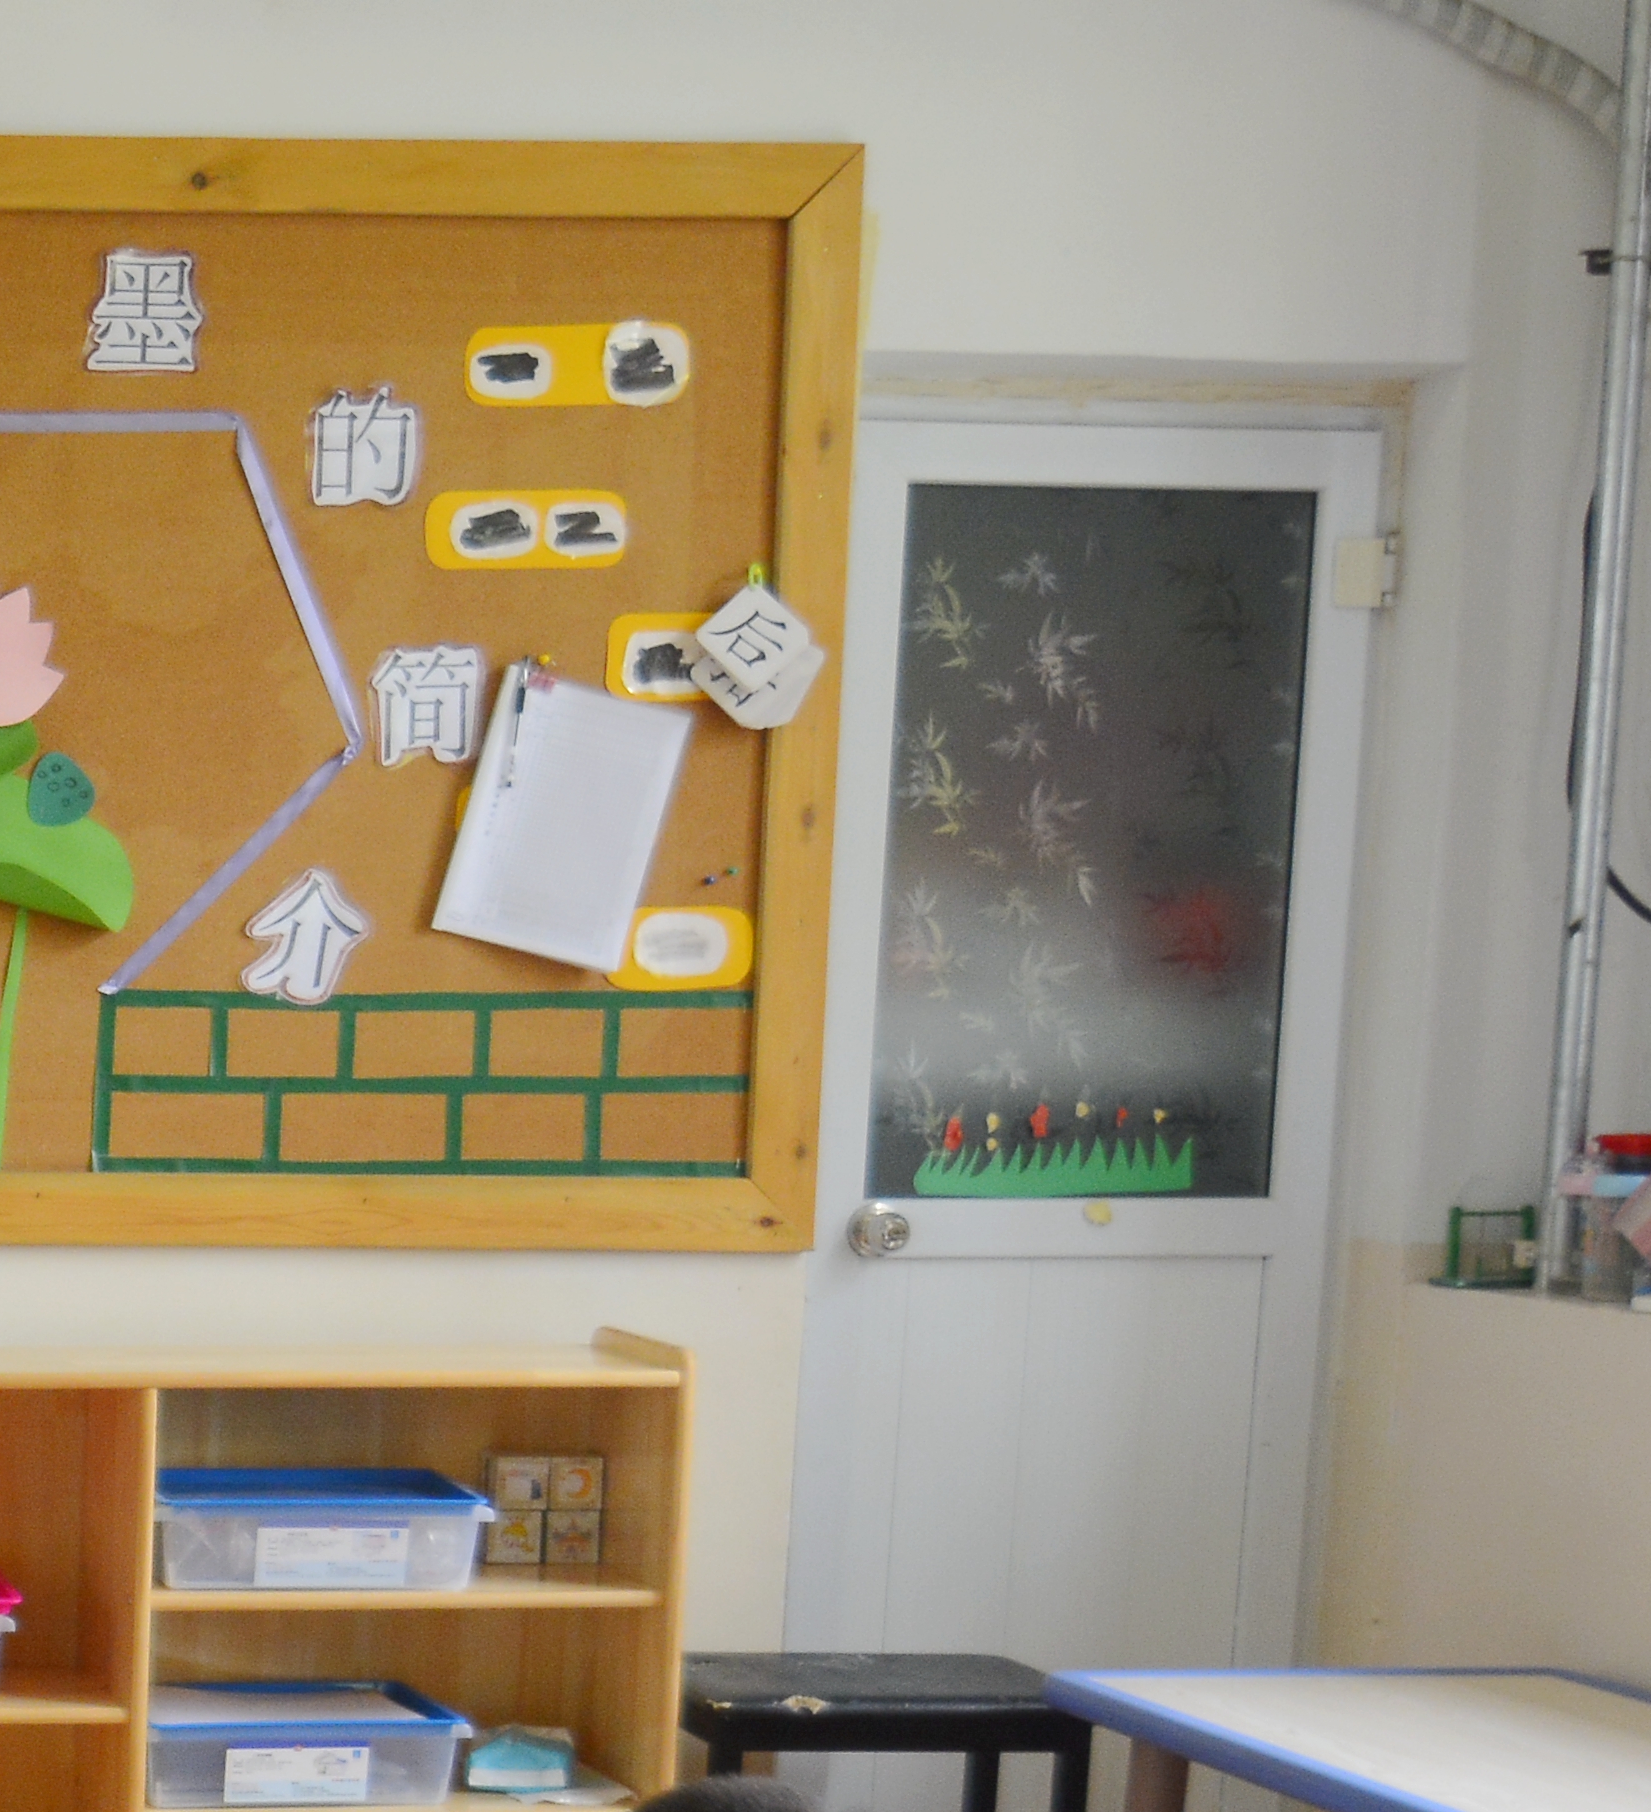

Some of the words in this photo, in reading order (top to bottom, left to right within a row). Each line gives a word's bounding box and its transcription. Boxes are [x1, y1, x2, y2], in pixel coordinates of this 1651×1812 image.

[94, 258, 193, 367] 墨
[314, 387, 412, 501] 的
[707, 610, 787, 667] 后
[371, 647, 476, 762] 简
[255, 876, 364, 990] 介
